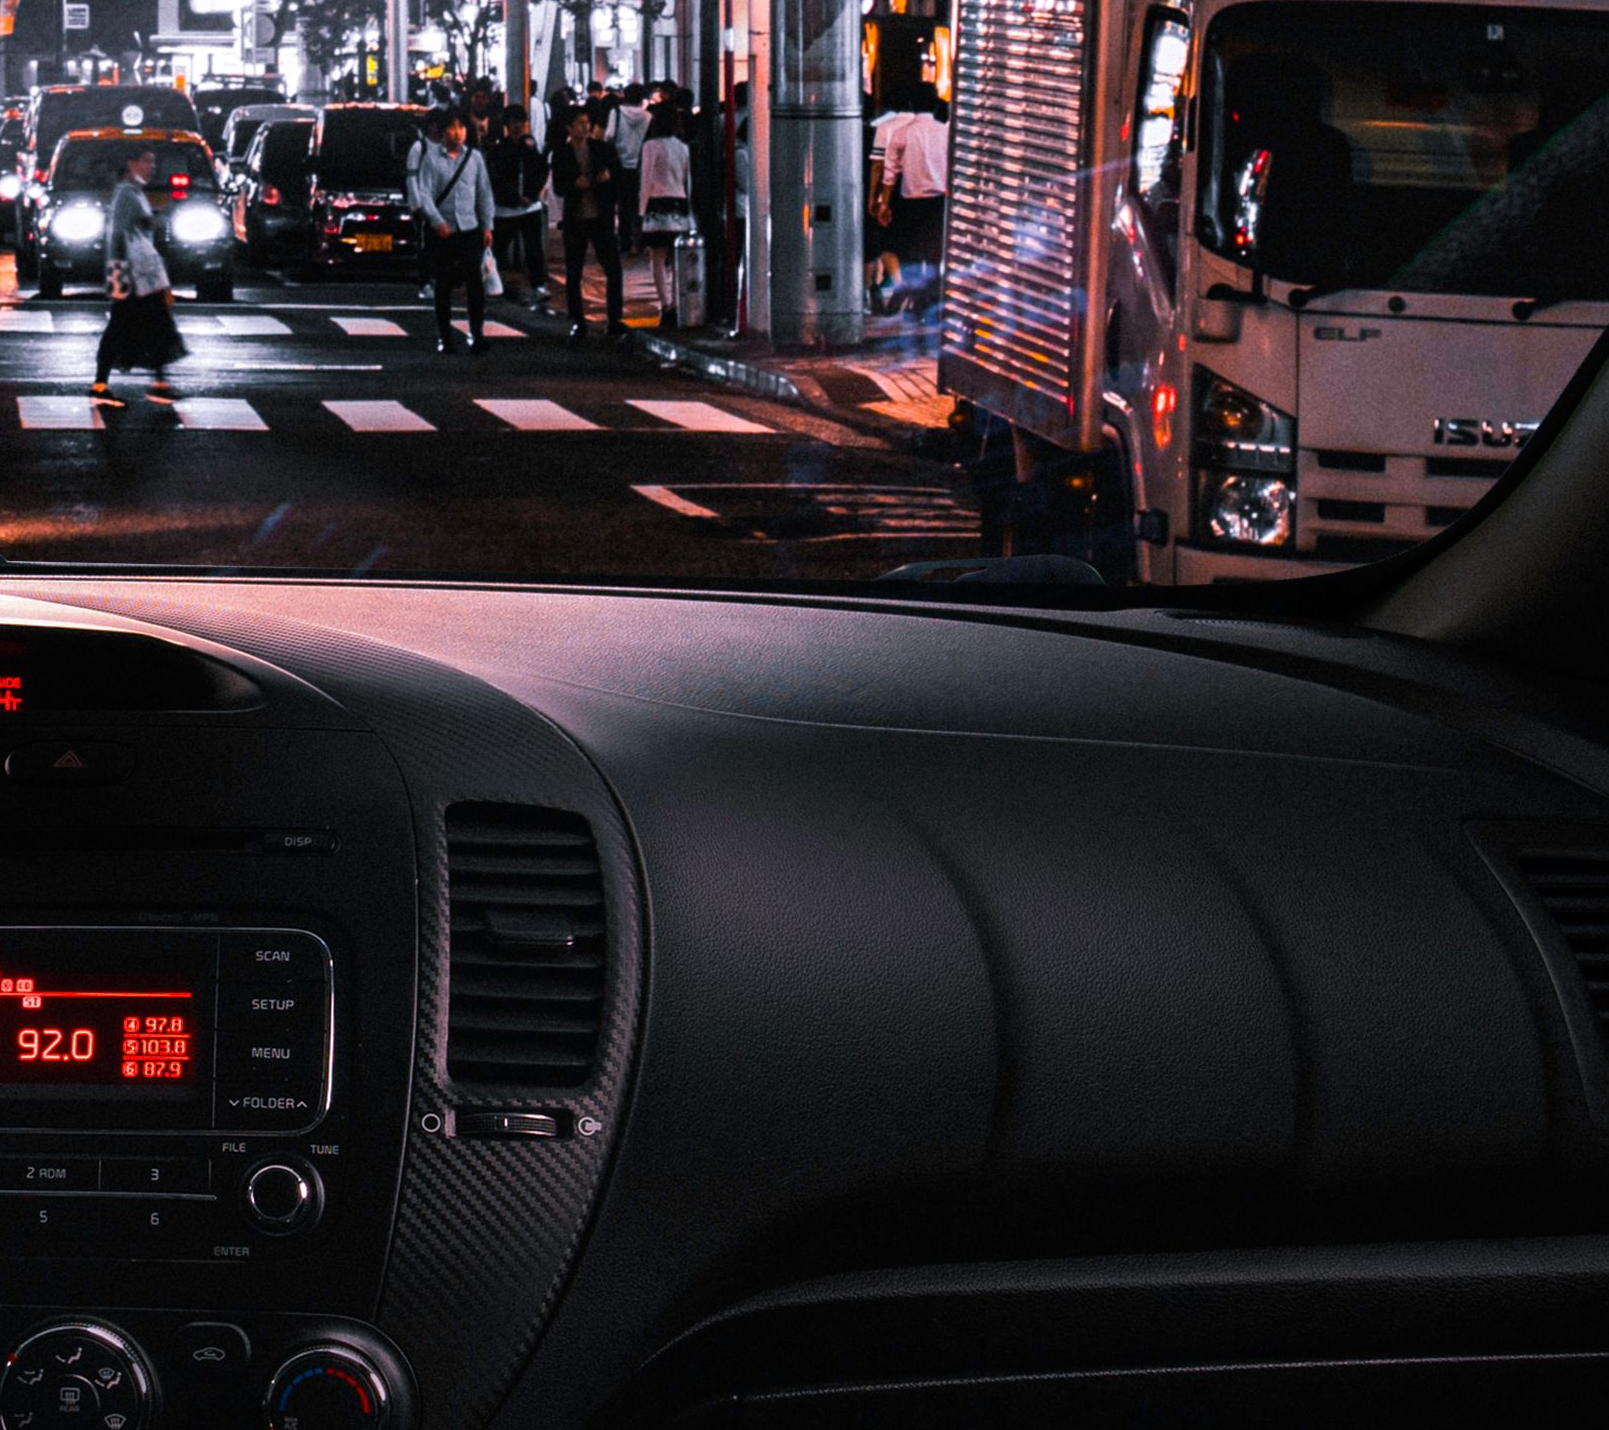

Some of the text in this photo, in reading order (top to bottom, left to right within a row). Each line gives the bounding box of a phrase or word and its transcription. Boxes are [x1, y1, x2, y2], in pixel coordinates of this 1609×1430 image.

[1313, 327, 1382, 341] ELF
[284, 836, 313, 847] DISP
[255, 950, 290, 962] SCAN
[251, 998, 295, 1011] SETUP
[145, 1018, 183, 1032] 97.8
[19, 1029, 94, 1060] 92.0
[141, 1039, 186, 1054] 103.8
[251, 1047, 291, 1059] MENU
[144, 1062, 181, 1076] 87.9
[242, 1097, 295, 1110] FOLDER
[222, 1142, 247, 1154] FILE
[309, 1144, 340, 1156] TUNE
[25, 1166, 35, 1178] 2
[150, 1168, 160, 1181] 3
[38, 1210, 49, 1223] 5
[150, 1212, 160, 1226] 6
[213, 1246, 250, 1257] ENTER
